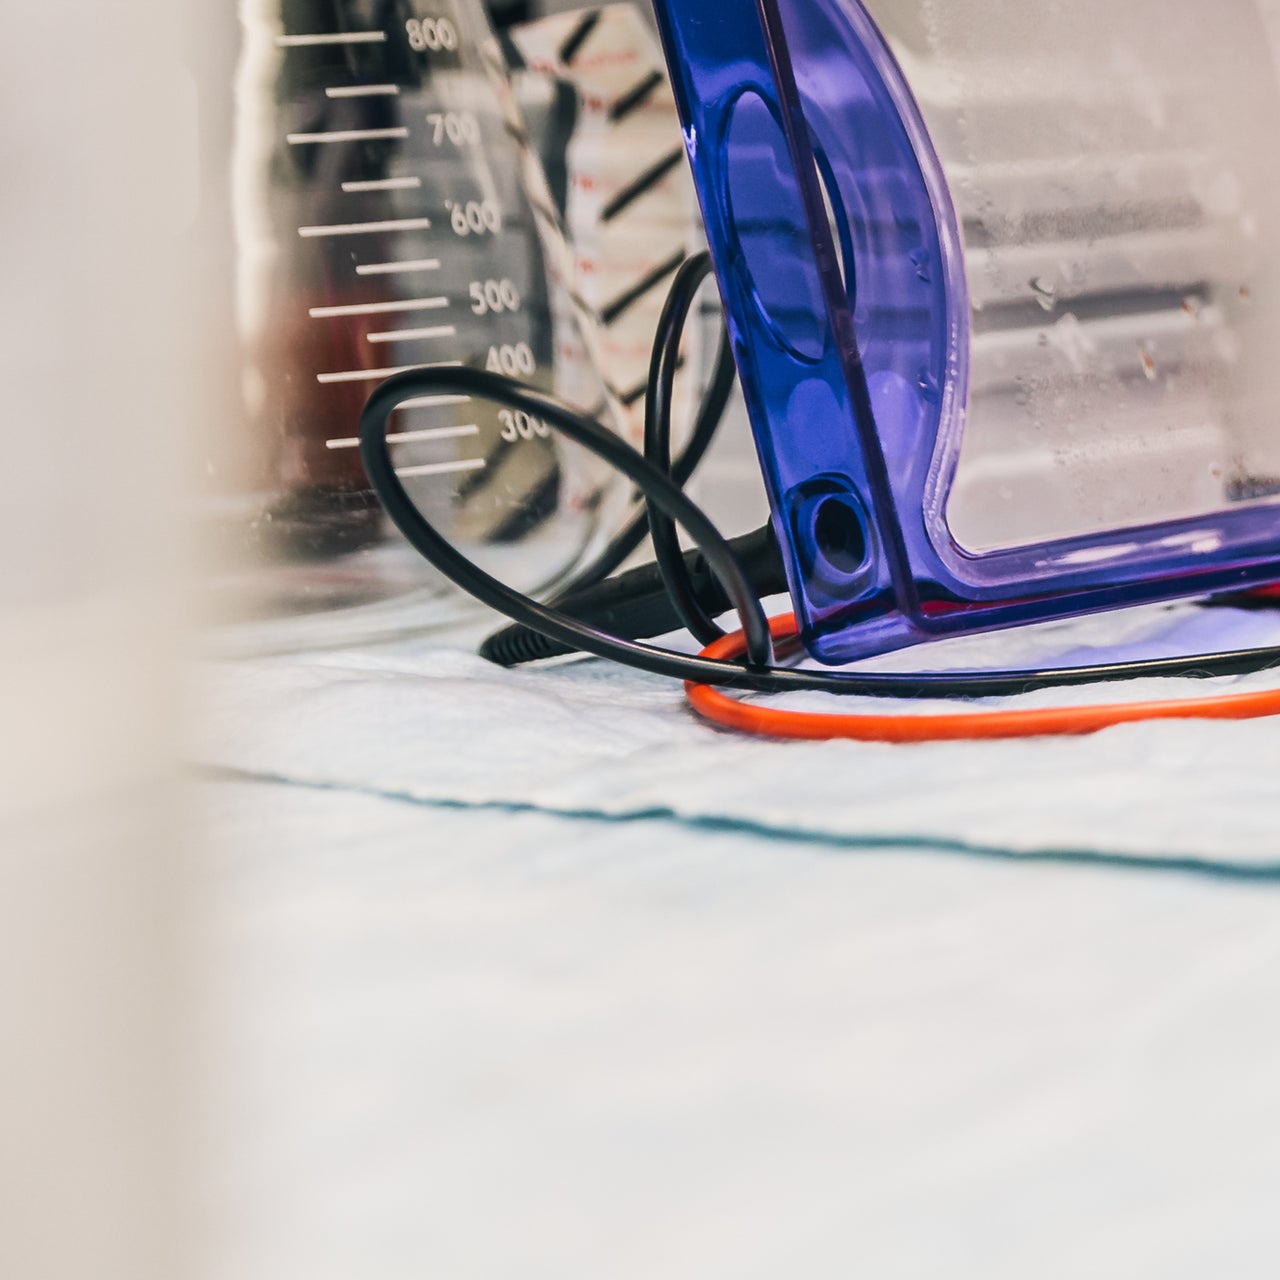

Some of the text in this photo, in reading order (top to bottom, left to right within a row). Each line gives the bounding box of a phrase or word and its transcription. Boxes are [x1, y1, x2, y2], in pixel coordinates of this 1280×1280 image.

[405, 17, 458, 52] 800
[426, 112, 480, 146] 700
[451, 200, 501, 236] 600
[469, 279, 520, 316] 500
[486, 342, 537, 377] 400
